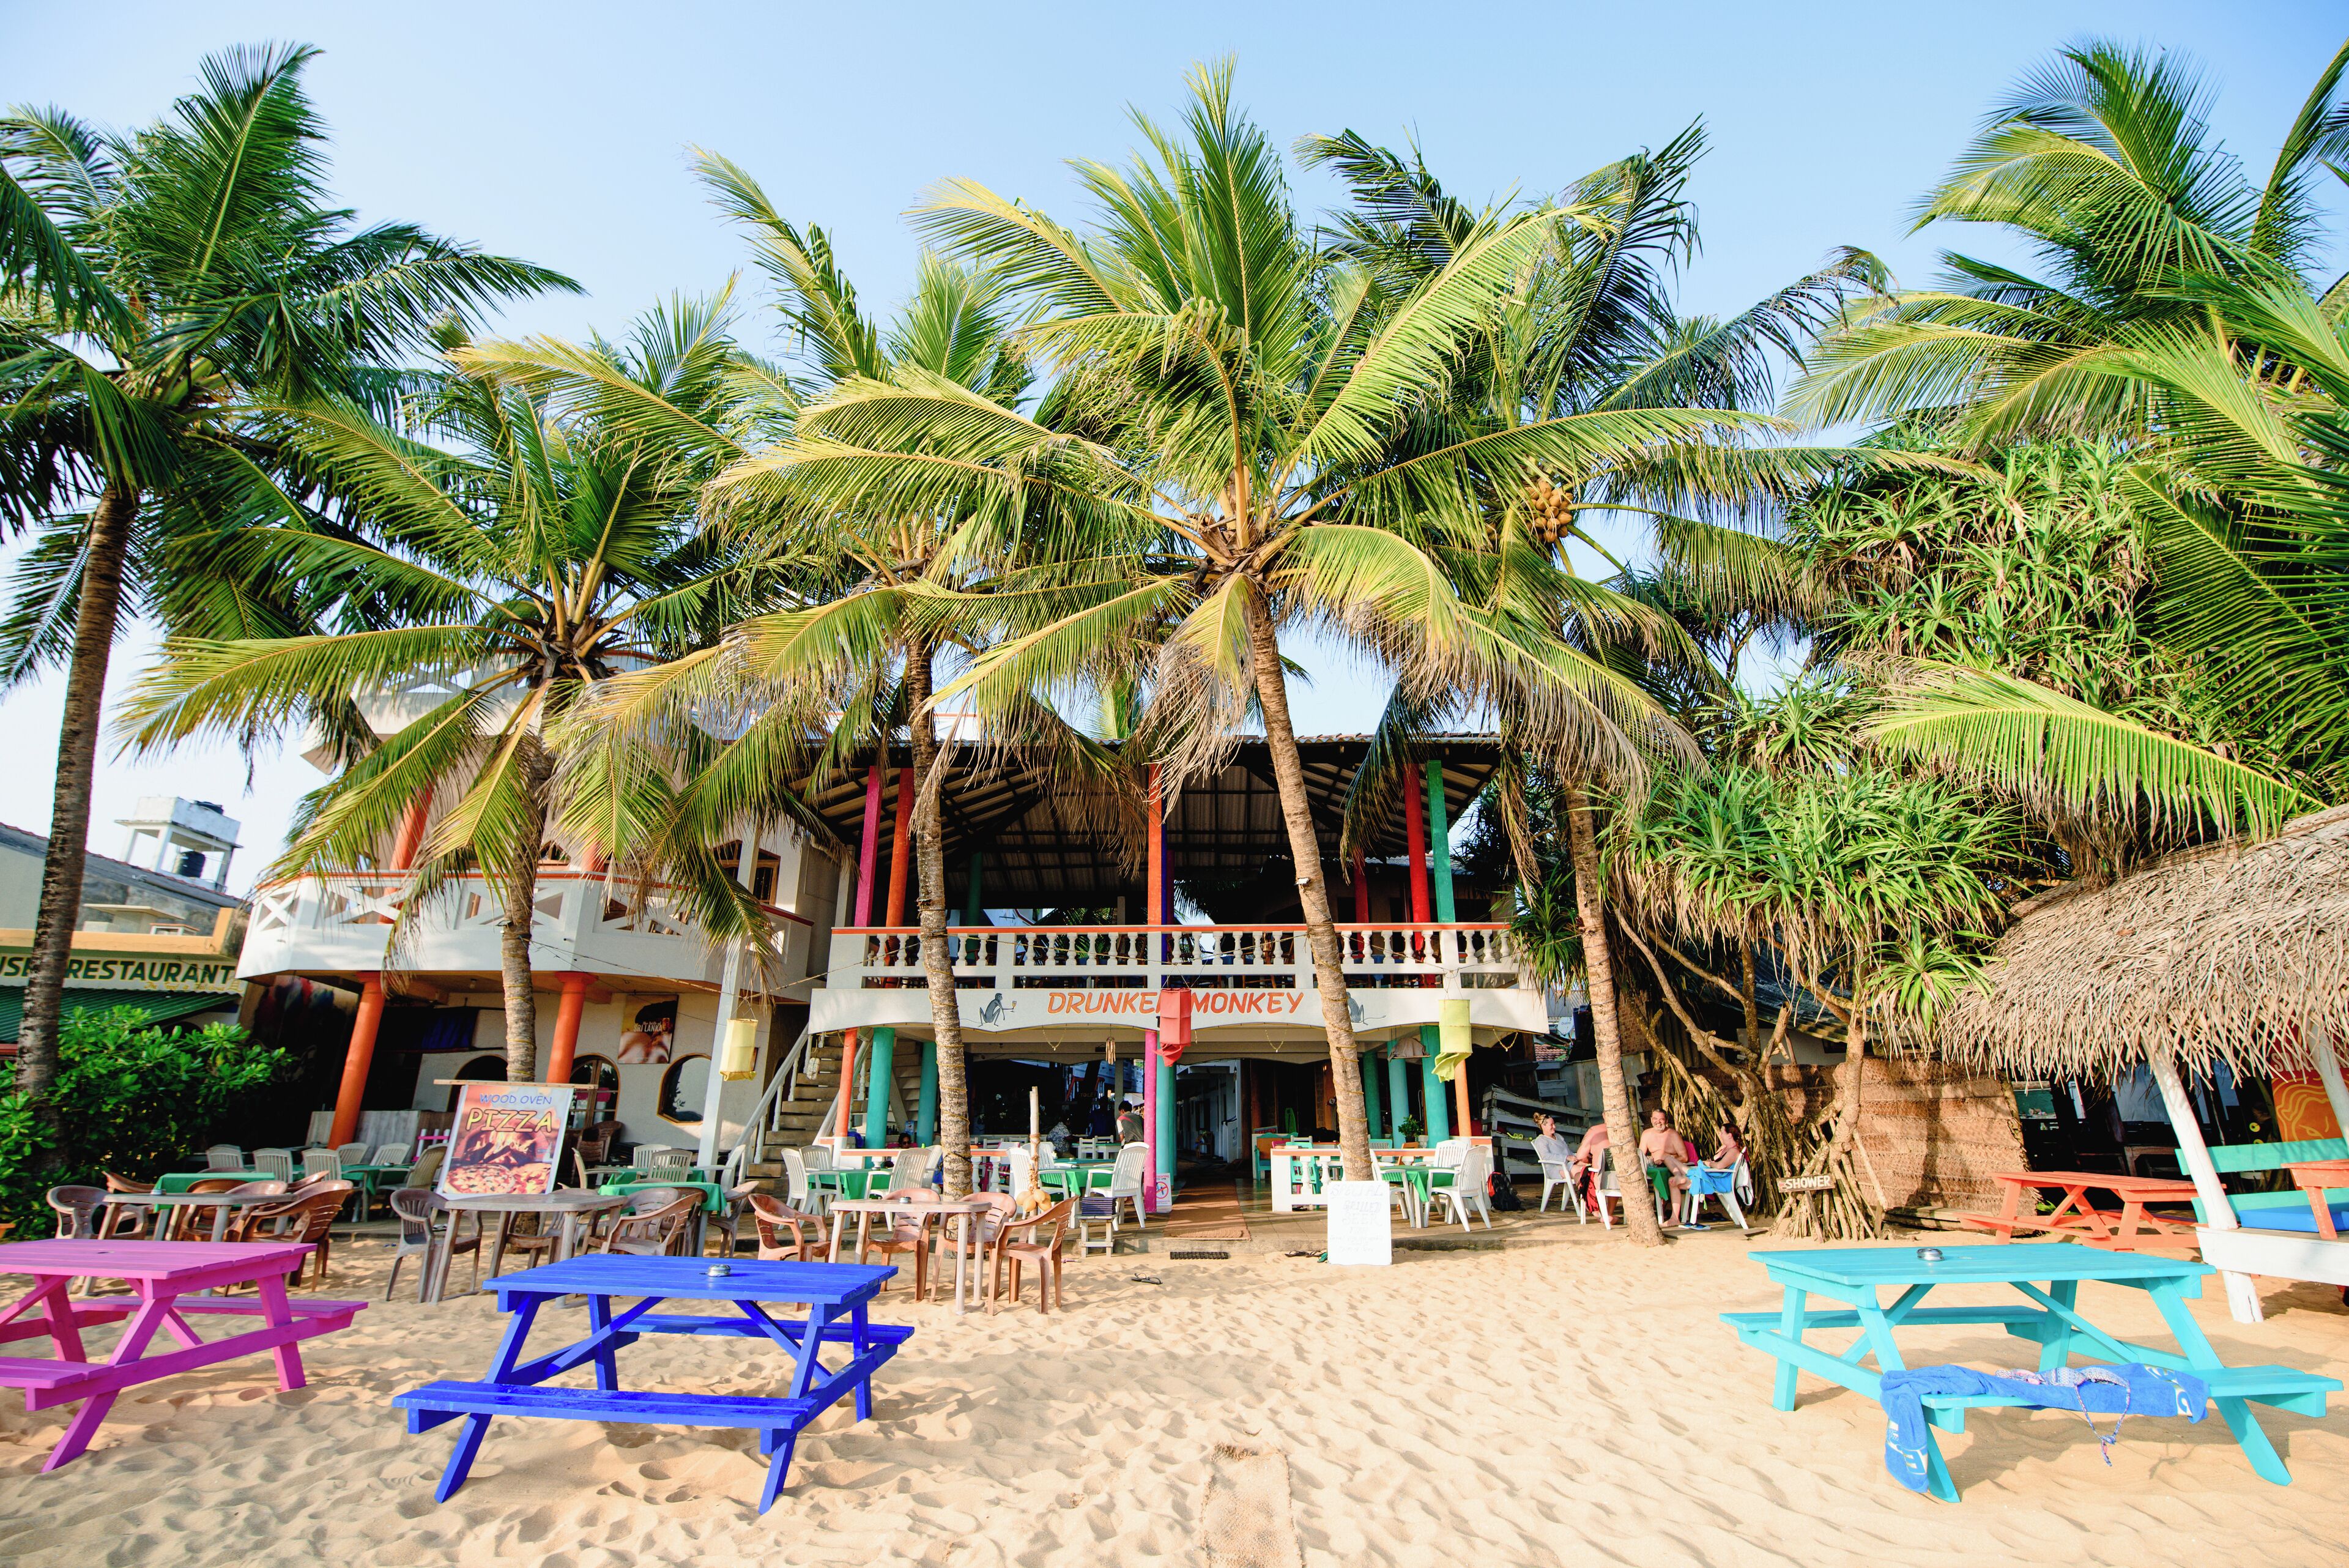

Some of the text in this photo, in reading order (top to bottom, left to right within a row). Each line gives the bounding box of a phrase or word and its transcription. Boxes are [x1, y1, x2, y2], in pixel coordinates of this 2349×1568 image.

[65, 957, 236, 984] RESTAURANT
[1047, 992, 1304, 1014] DRUNKE MONKEY
[633, 1024, 643, 1032] SRI
[479, 1093, 552, 1105] WOOD OVEN
[466, 1107, 552, 1132] PIZZA
[1786, 1175, 1831, 1189] SHOWER
